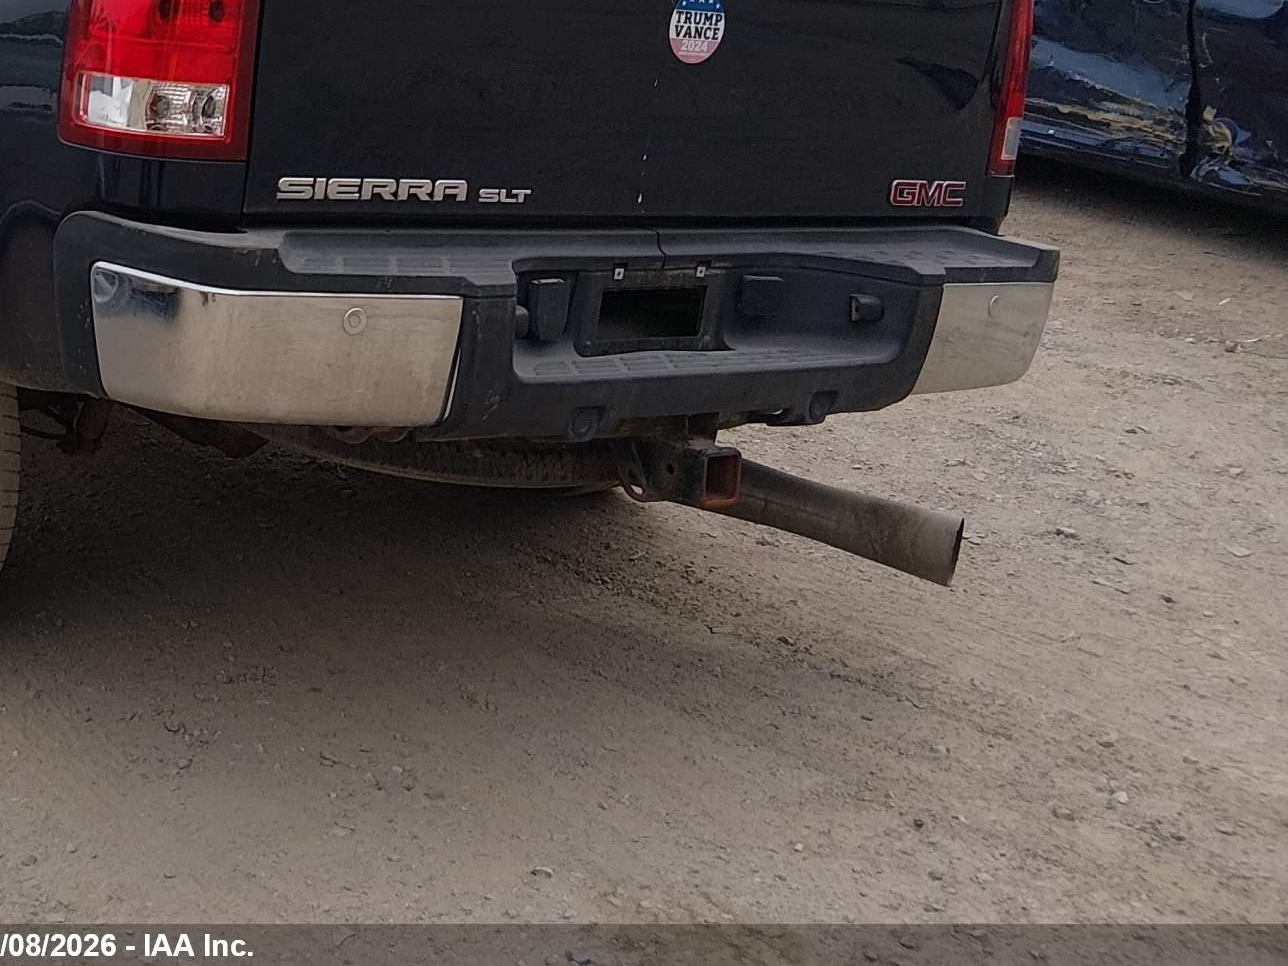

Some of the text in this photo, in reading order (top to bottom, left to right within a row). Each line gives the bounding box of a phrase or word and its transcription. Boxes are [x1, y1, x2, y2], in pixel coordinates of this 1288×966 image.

[676, 11, 722, 26] TRUMP
[675, 25, 720, 40] VANCE
[681, 39, 708, 52] 2024
[276, 177, 532, 203] SIERRA SLT
[890, 179, 966, 207] GMC
